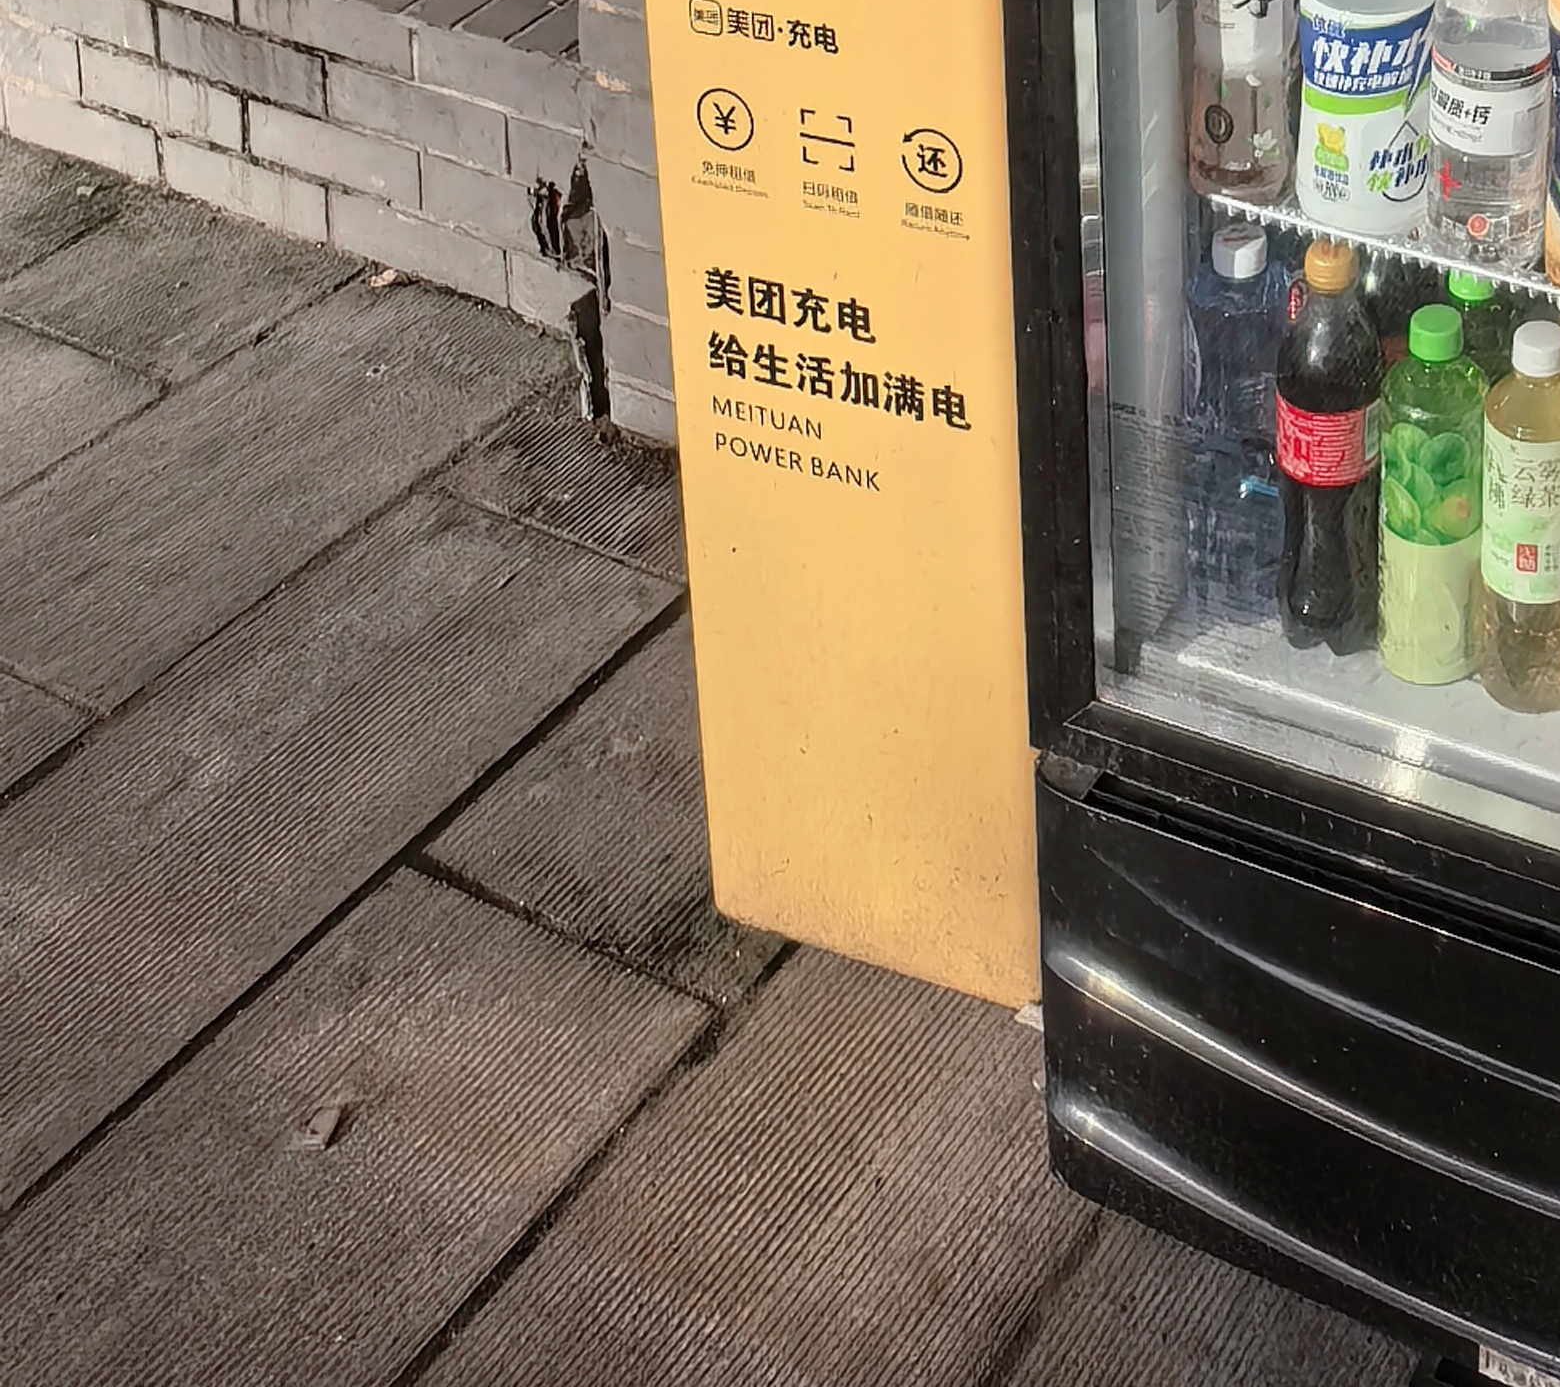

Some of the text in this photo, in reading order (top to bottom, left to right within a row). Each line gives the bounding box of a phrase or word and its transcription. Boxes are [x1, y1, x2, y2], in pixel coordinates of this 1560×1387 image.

[705, 267, 876, 344] 美团充电
[708, 330, 971, 431] 给生活加满电
[712, 395, 822, 441] MEITUAN
[715, 432, 881, 491] POWER BANK
